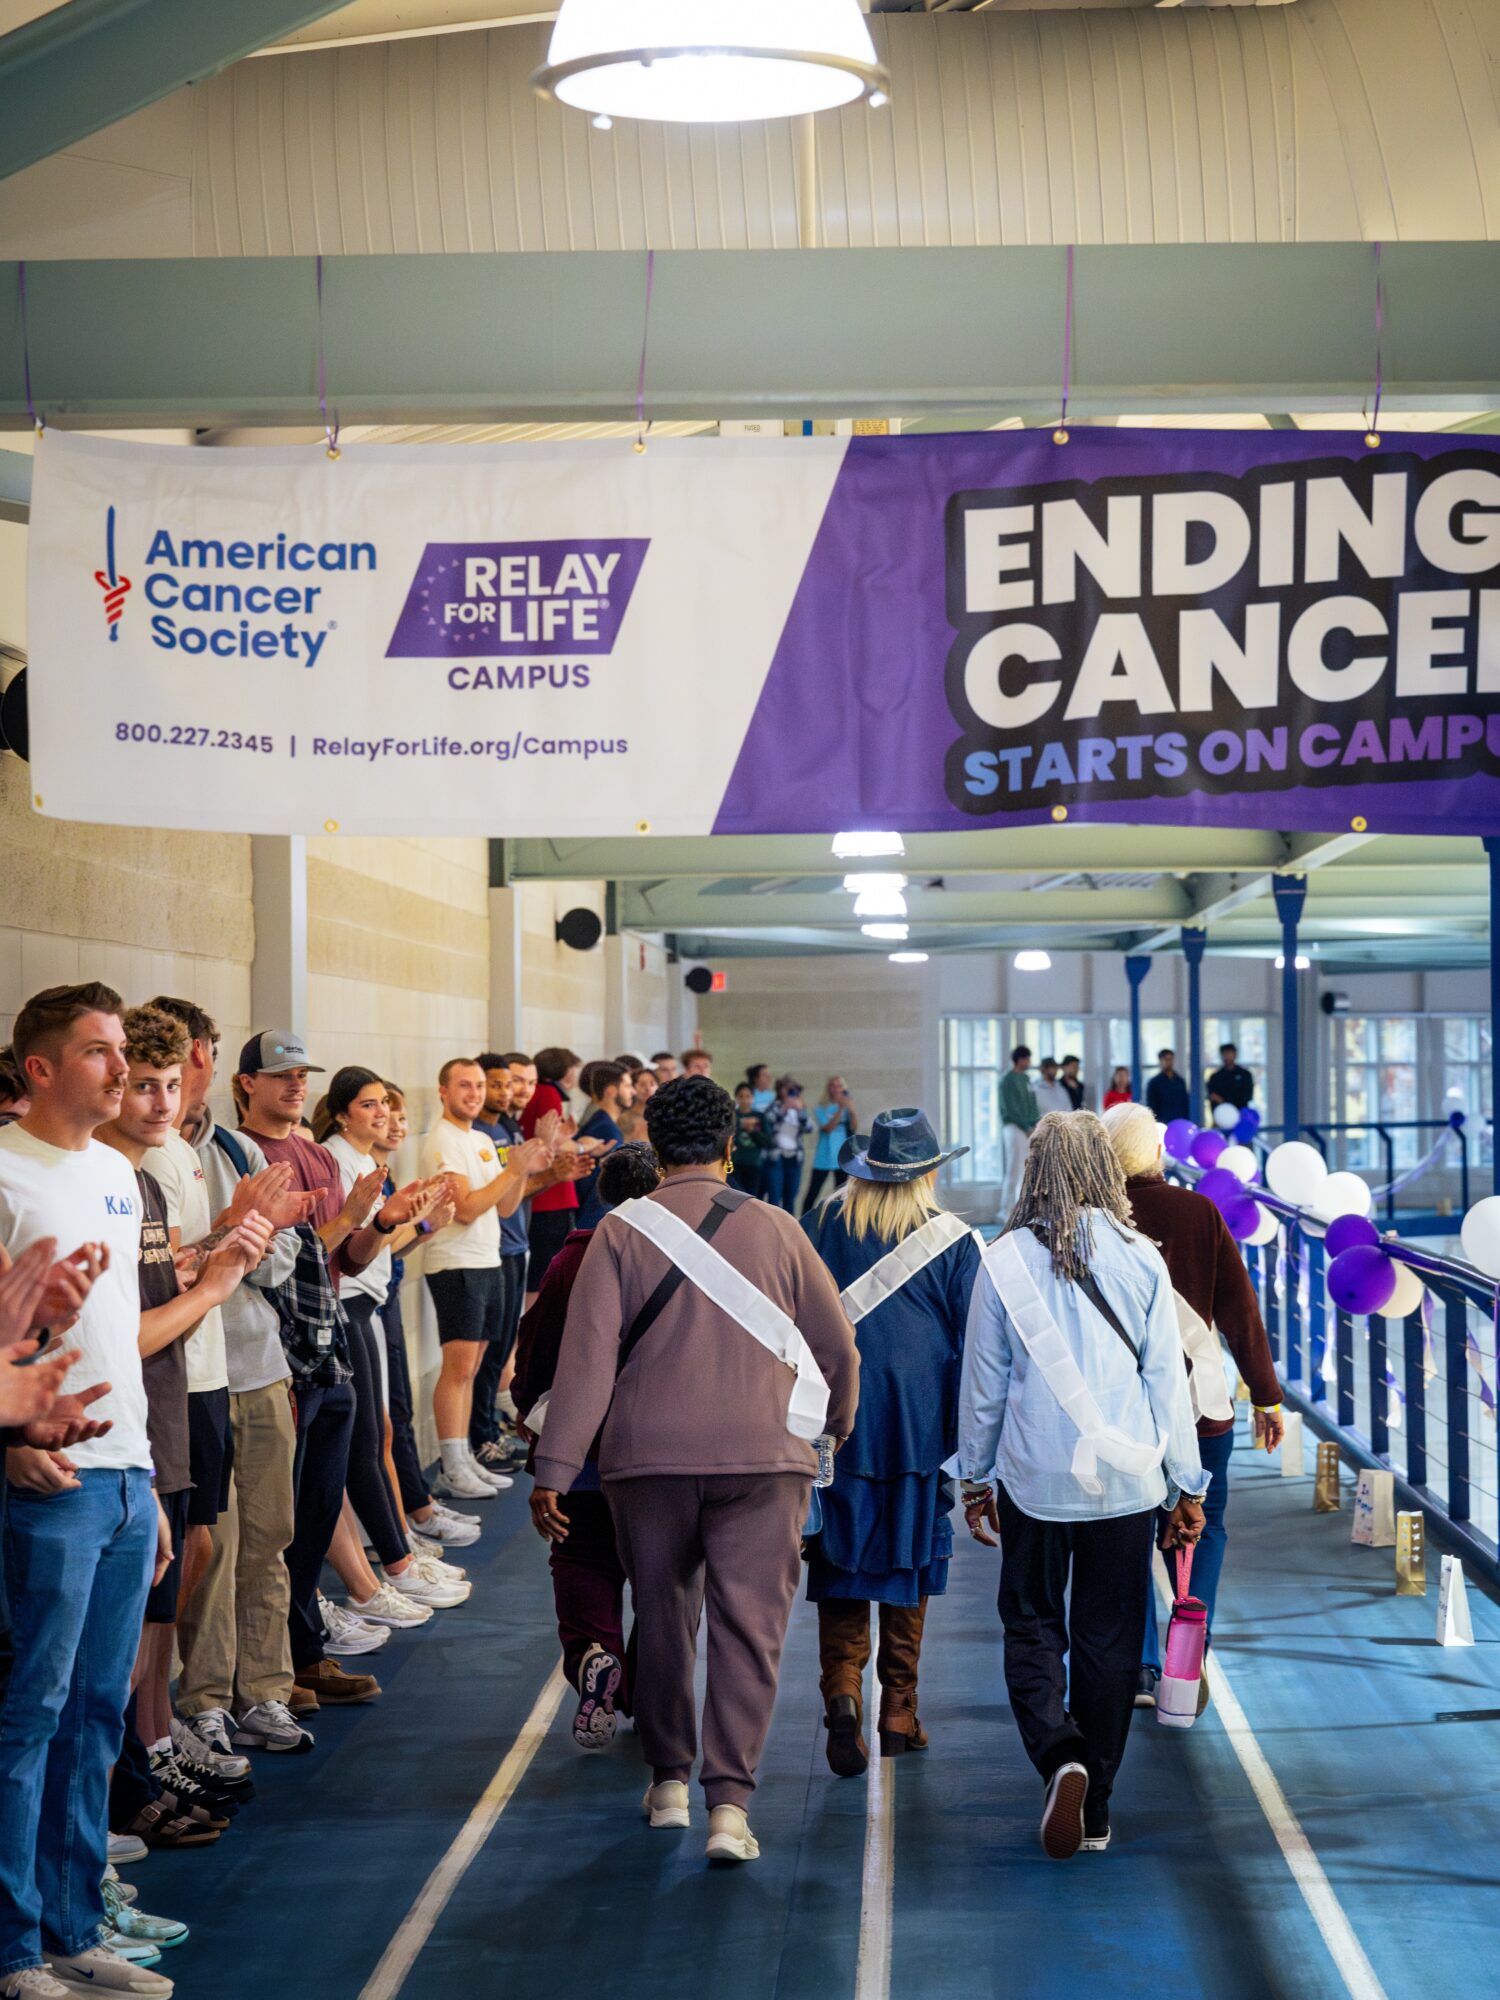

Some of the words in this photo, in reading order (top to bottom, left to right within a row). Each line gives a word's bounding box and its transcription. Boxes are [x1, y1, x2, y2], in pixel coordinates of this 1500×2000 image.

[145, 529, 376, 571] American
[964, 469, 1500, 612] ENDING
[144, 572, 321, 614] Cancer
[465, 552, 621, 598] RELAY
[444, 601, 496, 624] FOR
[447, 664, 590, 690] CAMPUS
[964, 588, 1500, 729] CANCE
[115, 722, 273, 753] 800.227.2345
[312, 731, 628, 761] RelayForLife.org/Campus
[964, 731, 1187, 796] STARTS
[1199, 726, 1288, 775] ON
